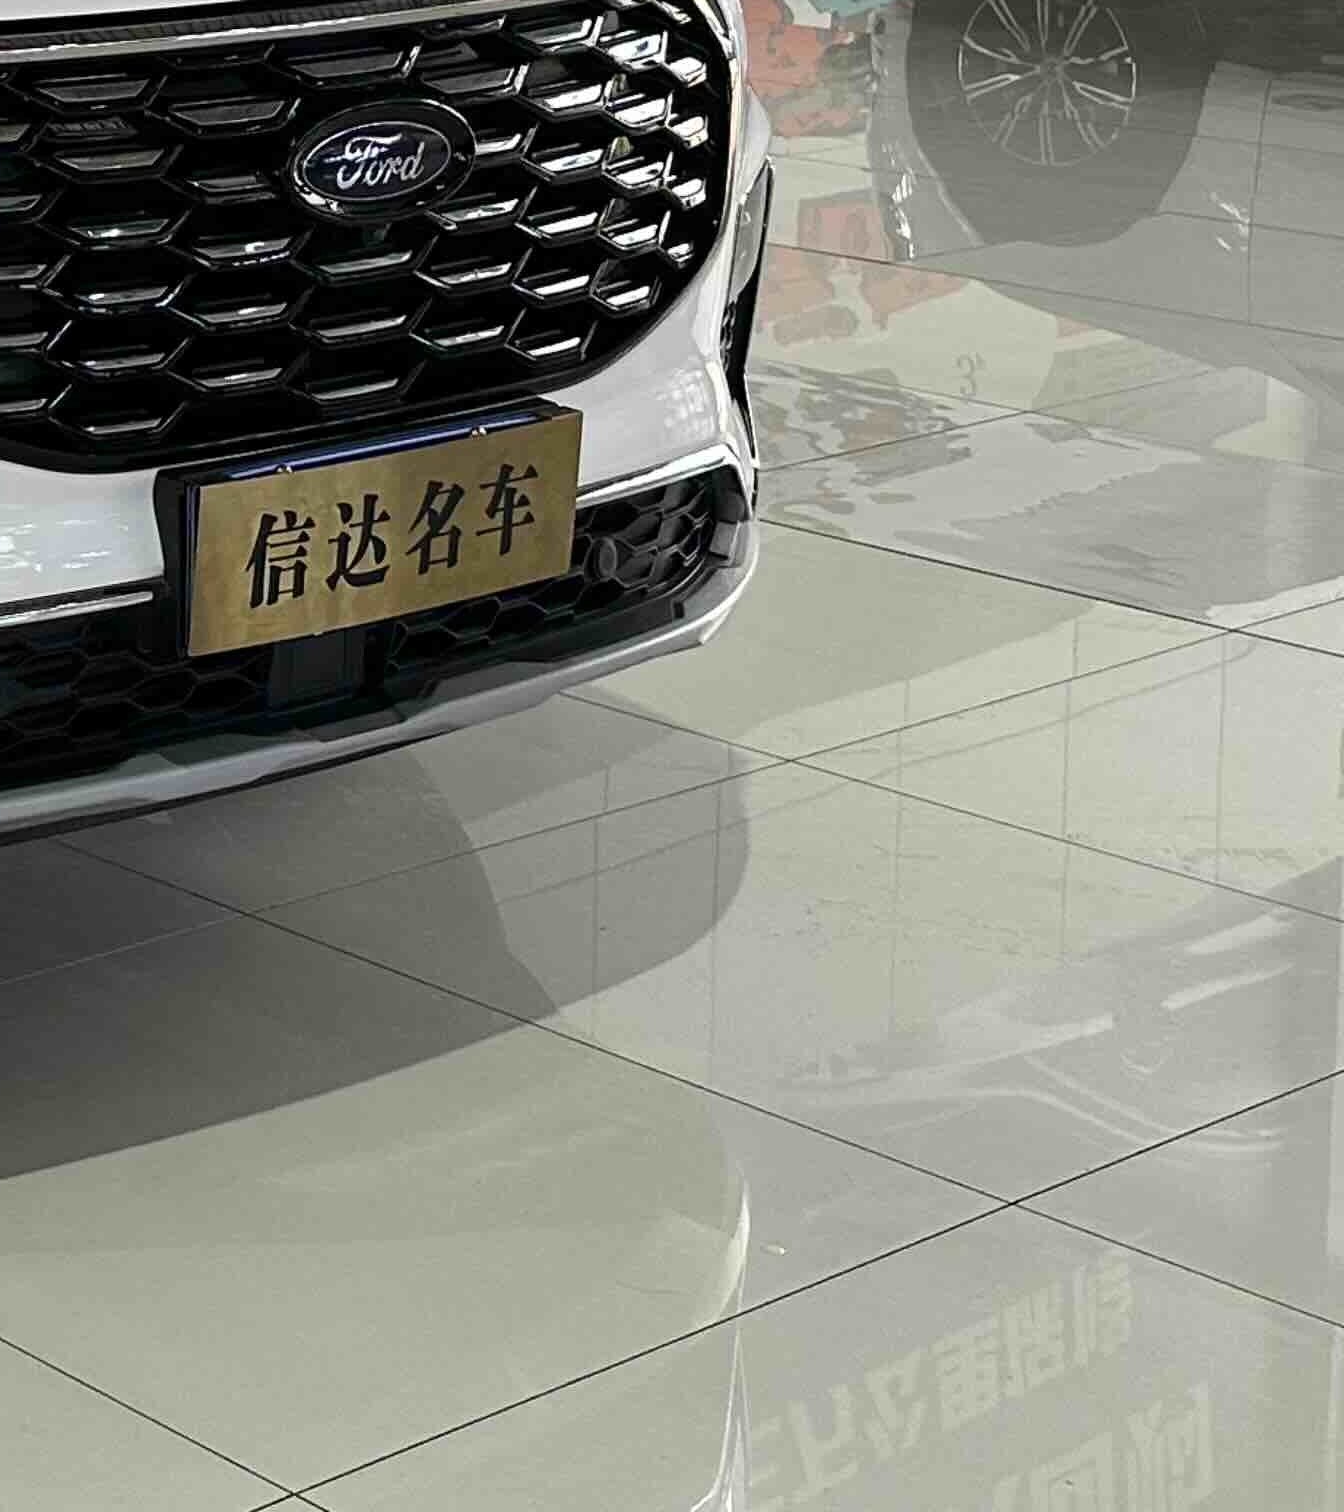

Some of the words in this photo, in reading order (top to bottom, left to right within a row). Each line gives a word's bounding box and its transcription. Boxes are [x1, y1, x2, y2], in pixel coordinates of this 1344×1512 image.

[325, 132, 426, 190] Ford
[246, 463, 539, 609] 信达名车
